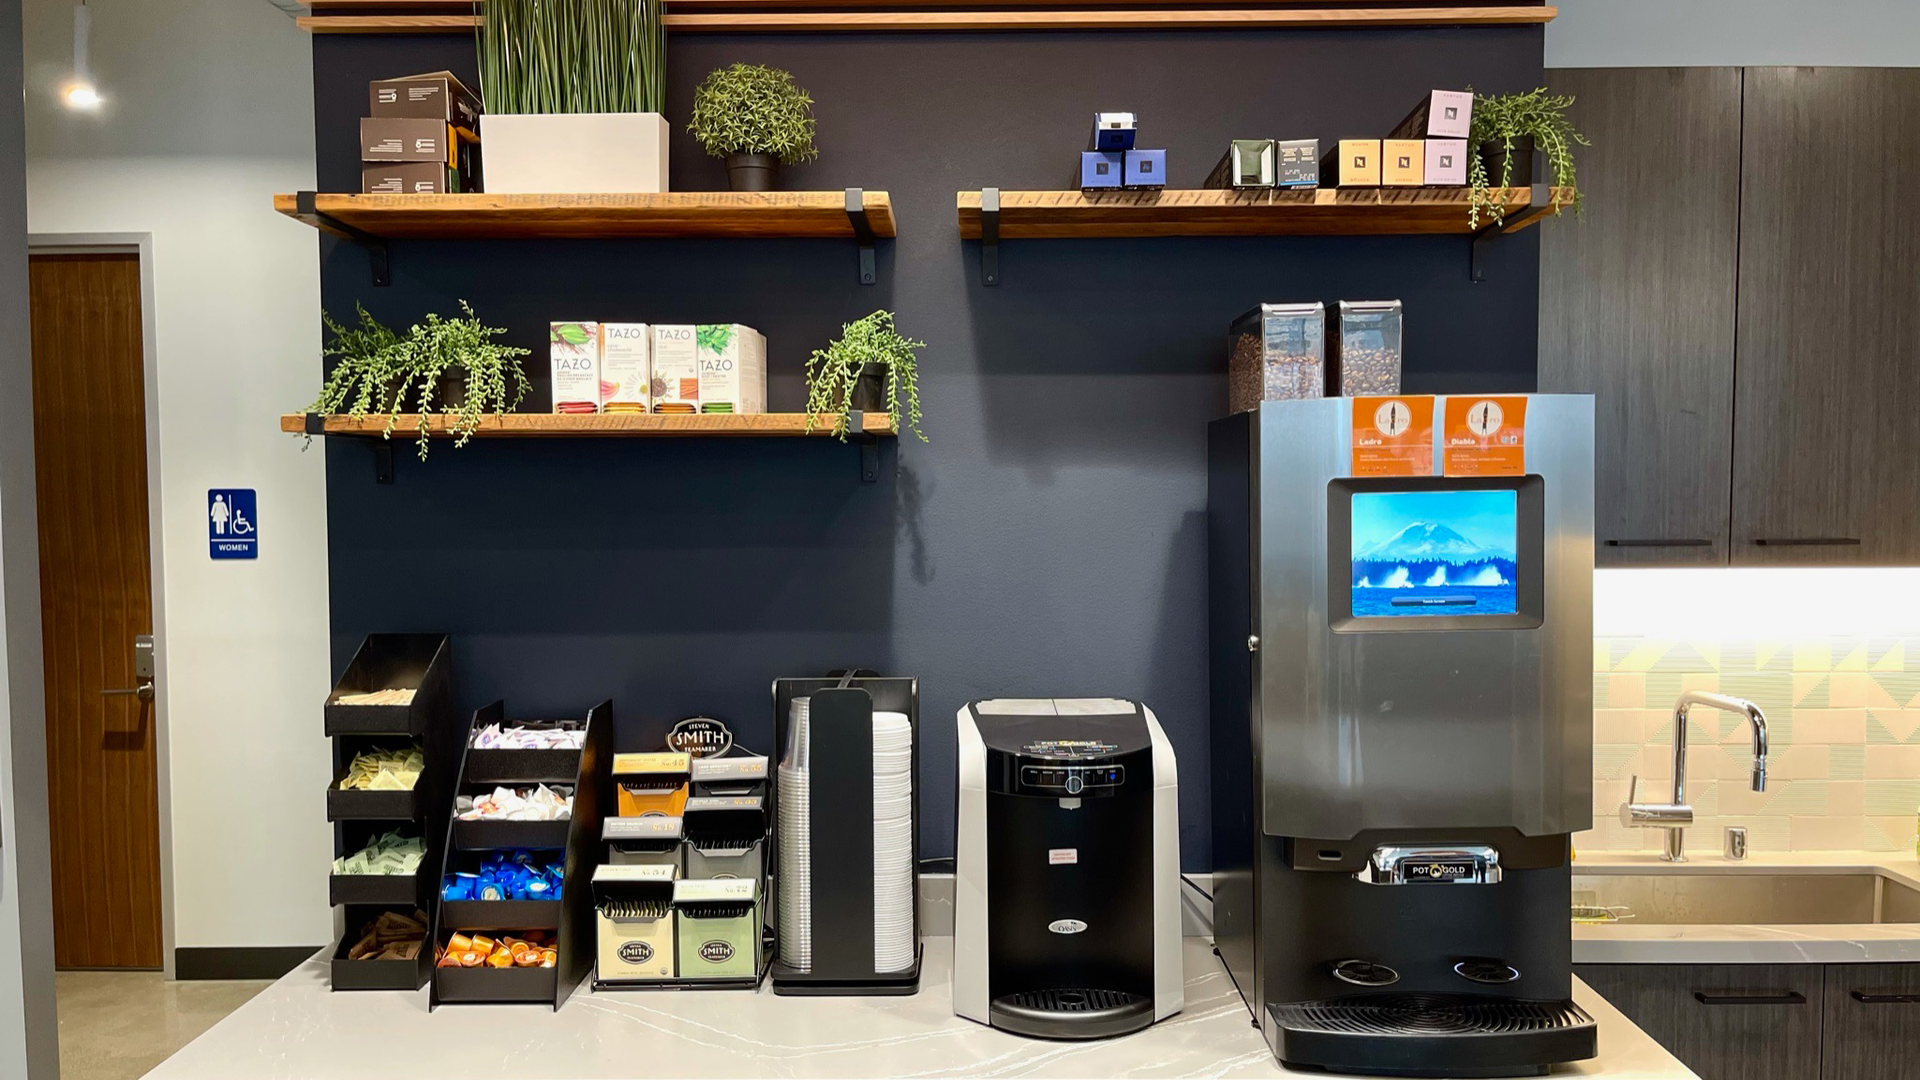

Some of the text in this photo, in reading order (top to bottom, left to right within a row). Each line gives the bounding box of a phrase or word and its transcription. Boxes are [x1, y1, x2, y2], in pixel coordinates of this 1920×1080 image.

[608, 328, 641, 340] TAZO
[658, 329, 691, 341] TAZO
[554, 358, 592, 371] TAZO
[699, 359, 733, 371] TAZO
[1378, 414, 1408, 424] Laro
[1470, 413, 1500, 423] Laro
[218, 543, 249, 552] WOMEN
[676, 730, 724, 746] SMITH
[1443, 866, 1466, 874] GOLD
[622, 948, 649, 956] SMITH
[703, 947, 730, 956] SMITH
